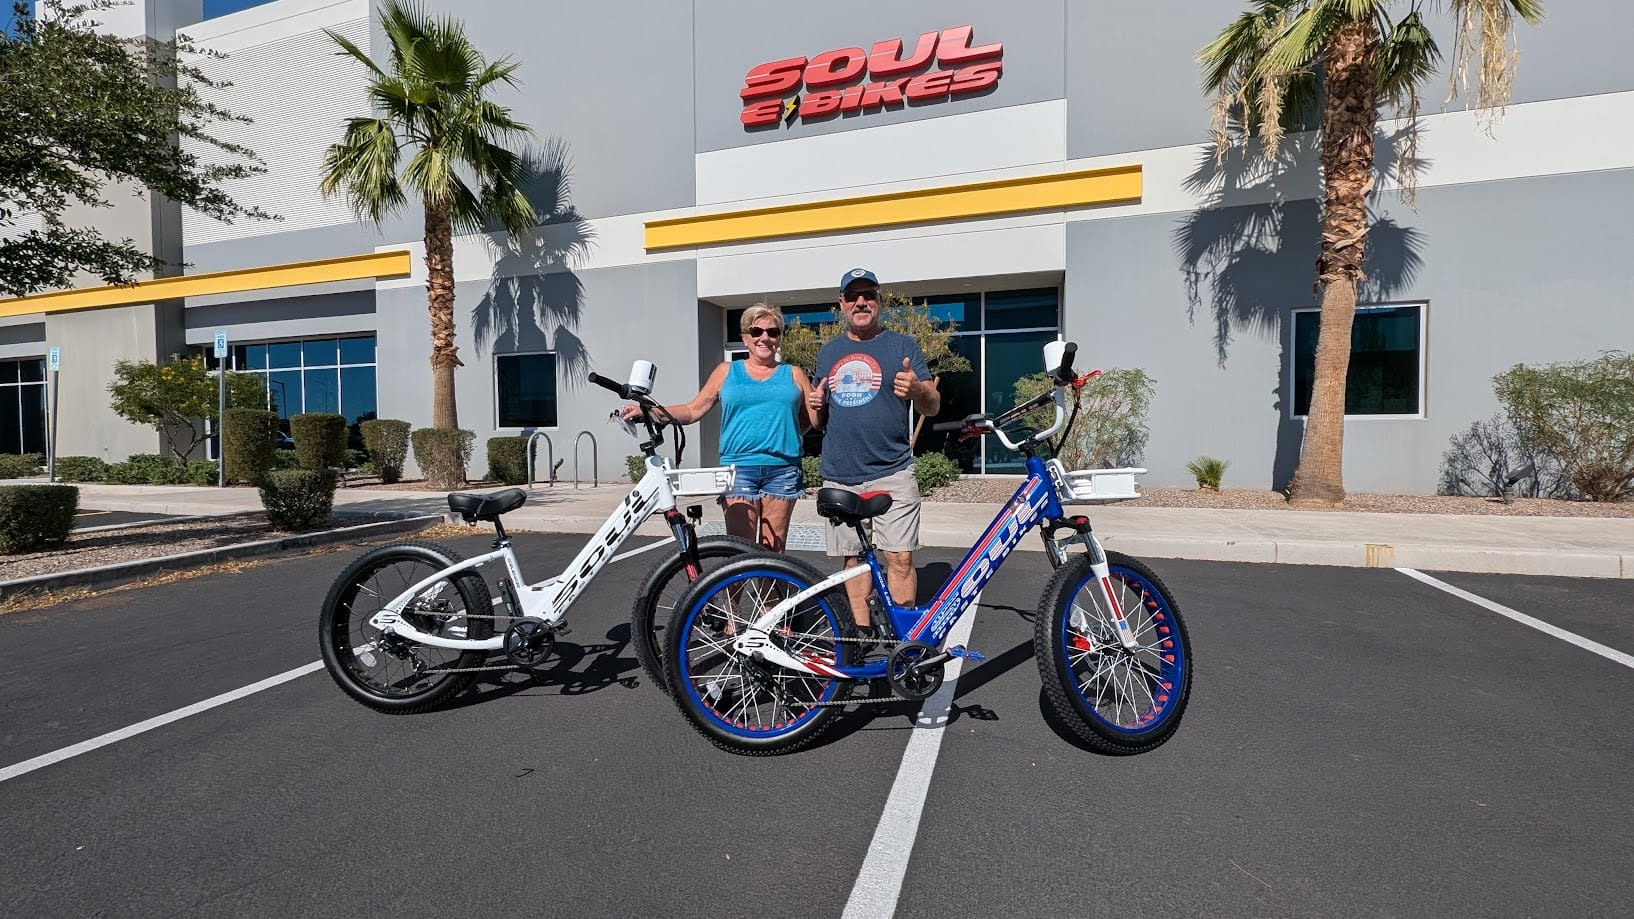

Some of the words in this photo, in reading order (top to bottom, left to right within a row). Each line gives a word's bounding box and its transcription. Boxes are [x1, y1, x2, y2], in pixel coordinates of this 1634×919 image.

[739, 24, 1003, 100] SOUL
[798, 61, 1003, 120] BIKES
[842, 393, 873, 406] PRESIDENT
[551, 486, 660, 614] SOUL
[930, 491, 1049, 639] SOUL
[938, 586, 979, 639] FAST
